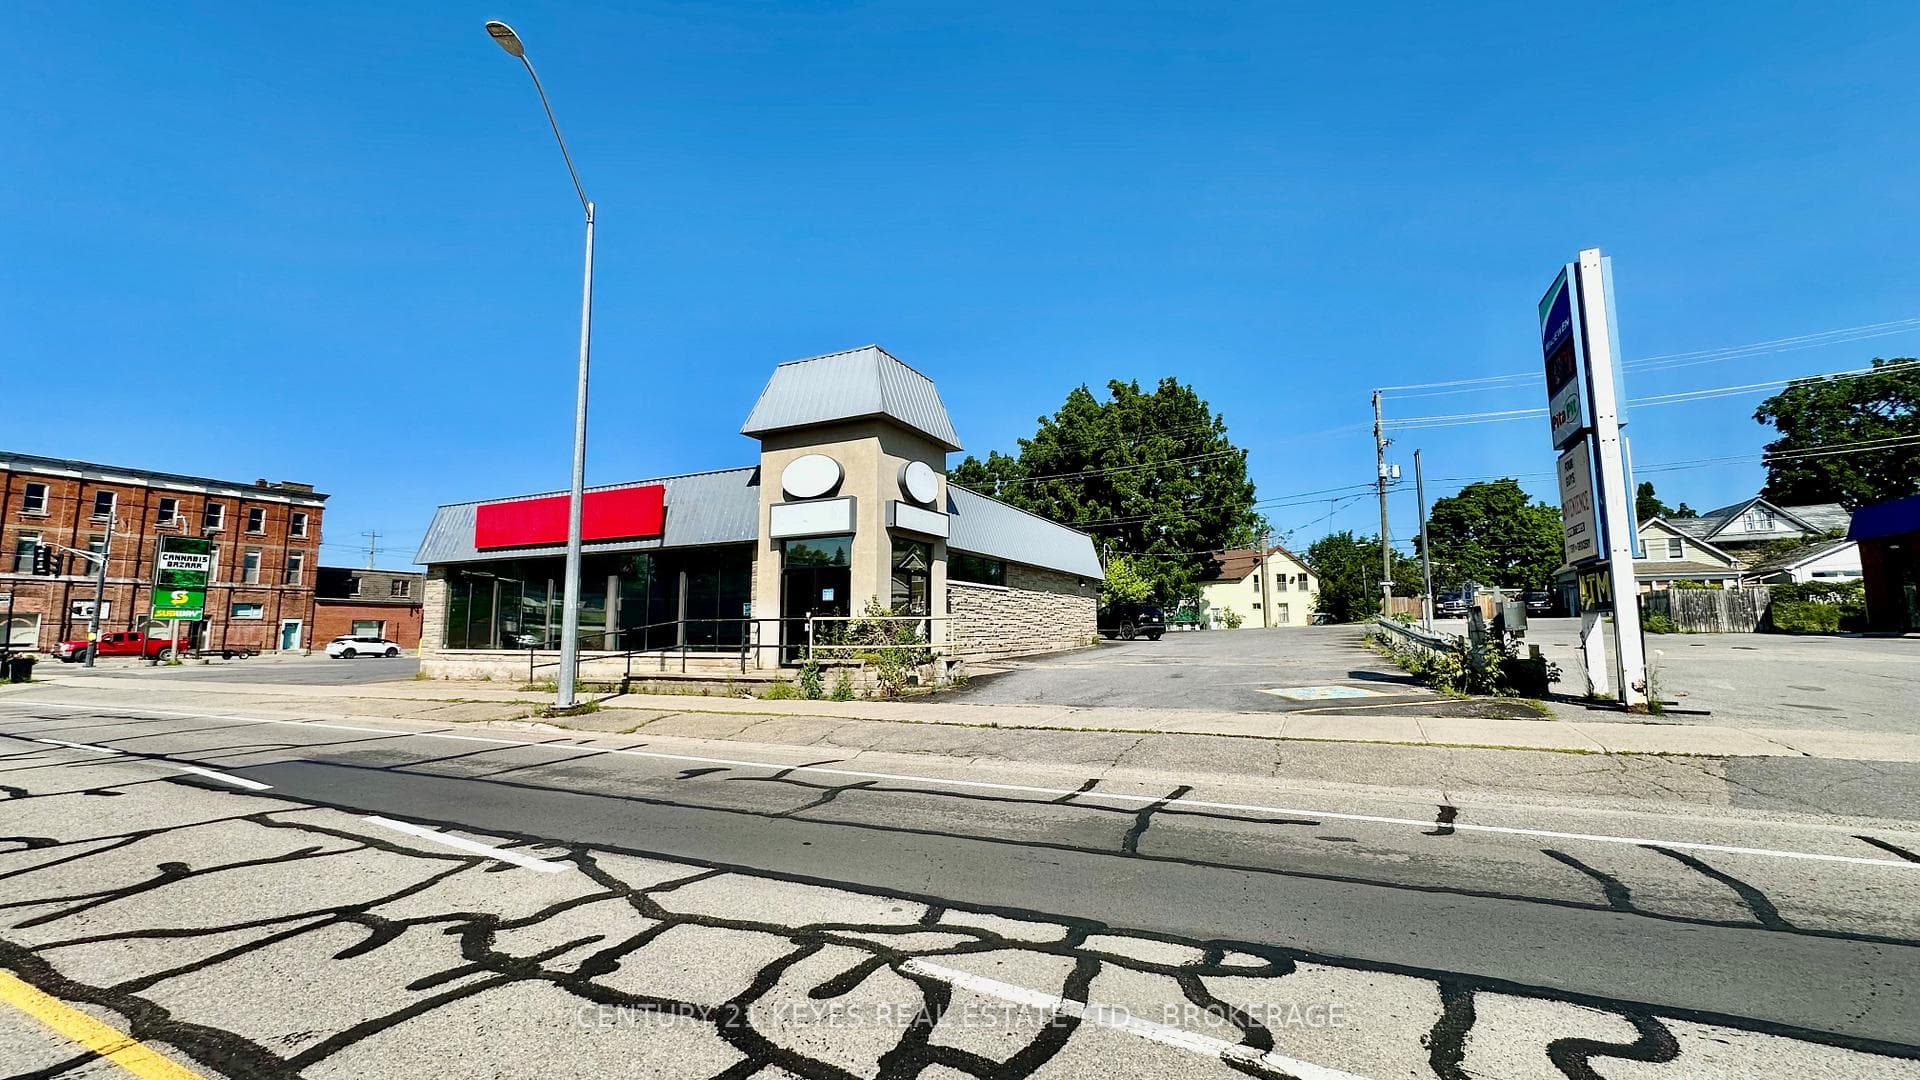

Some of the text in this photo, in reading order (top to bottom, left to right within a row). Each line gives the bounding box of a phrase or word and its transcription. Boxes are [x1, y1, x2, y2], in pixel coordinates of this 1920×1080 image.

[1552, 399, 1577, 431] Pita Pit
[162, 553, 208, 563] CANNABIS
[167, 561, 202, 569] BAZAAR
[154, 609, 202, 618] SUBWAY
